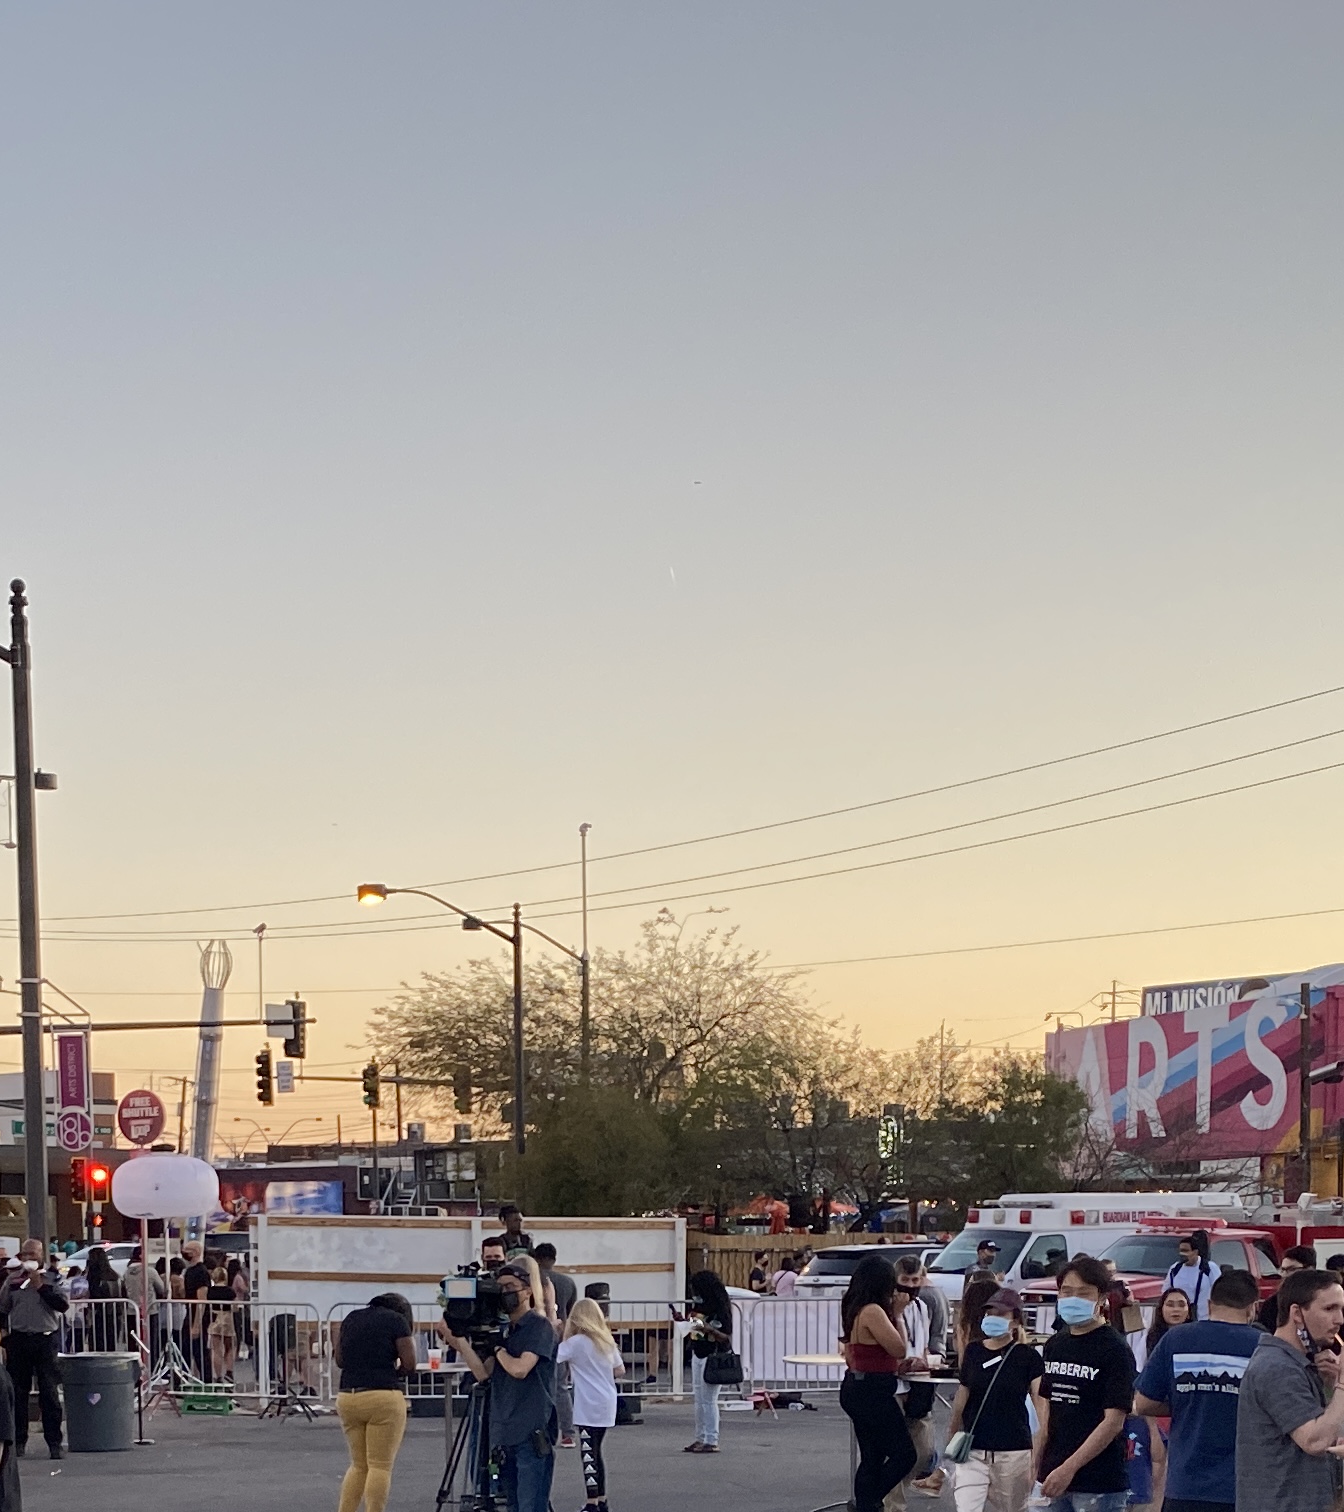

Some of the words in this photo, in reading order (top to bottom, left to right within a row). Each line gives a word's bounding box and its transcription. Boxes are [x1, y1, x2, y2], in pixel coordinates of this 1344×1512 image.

[66, 1043, 77, 1079] DISTRICT
[1075, 999, 1288, 1142] ARTS
[122, 1106, 160, 1118] SHUTTLE
[129, 1096, 151, 1107] FREE
[58, 1112, 91, 1149] 18b
